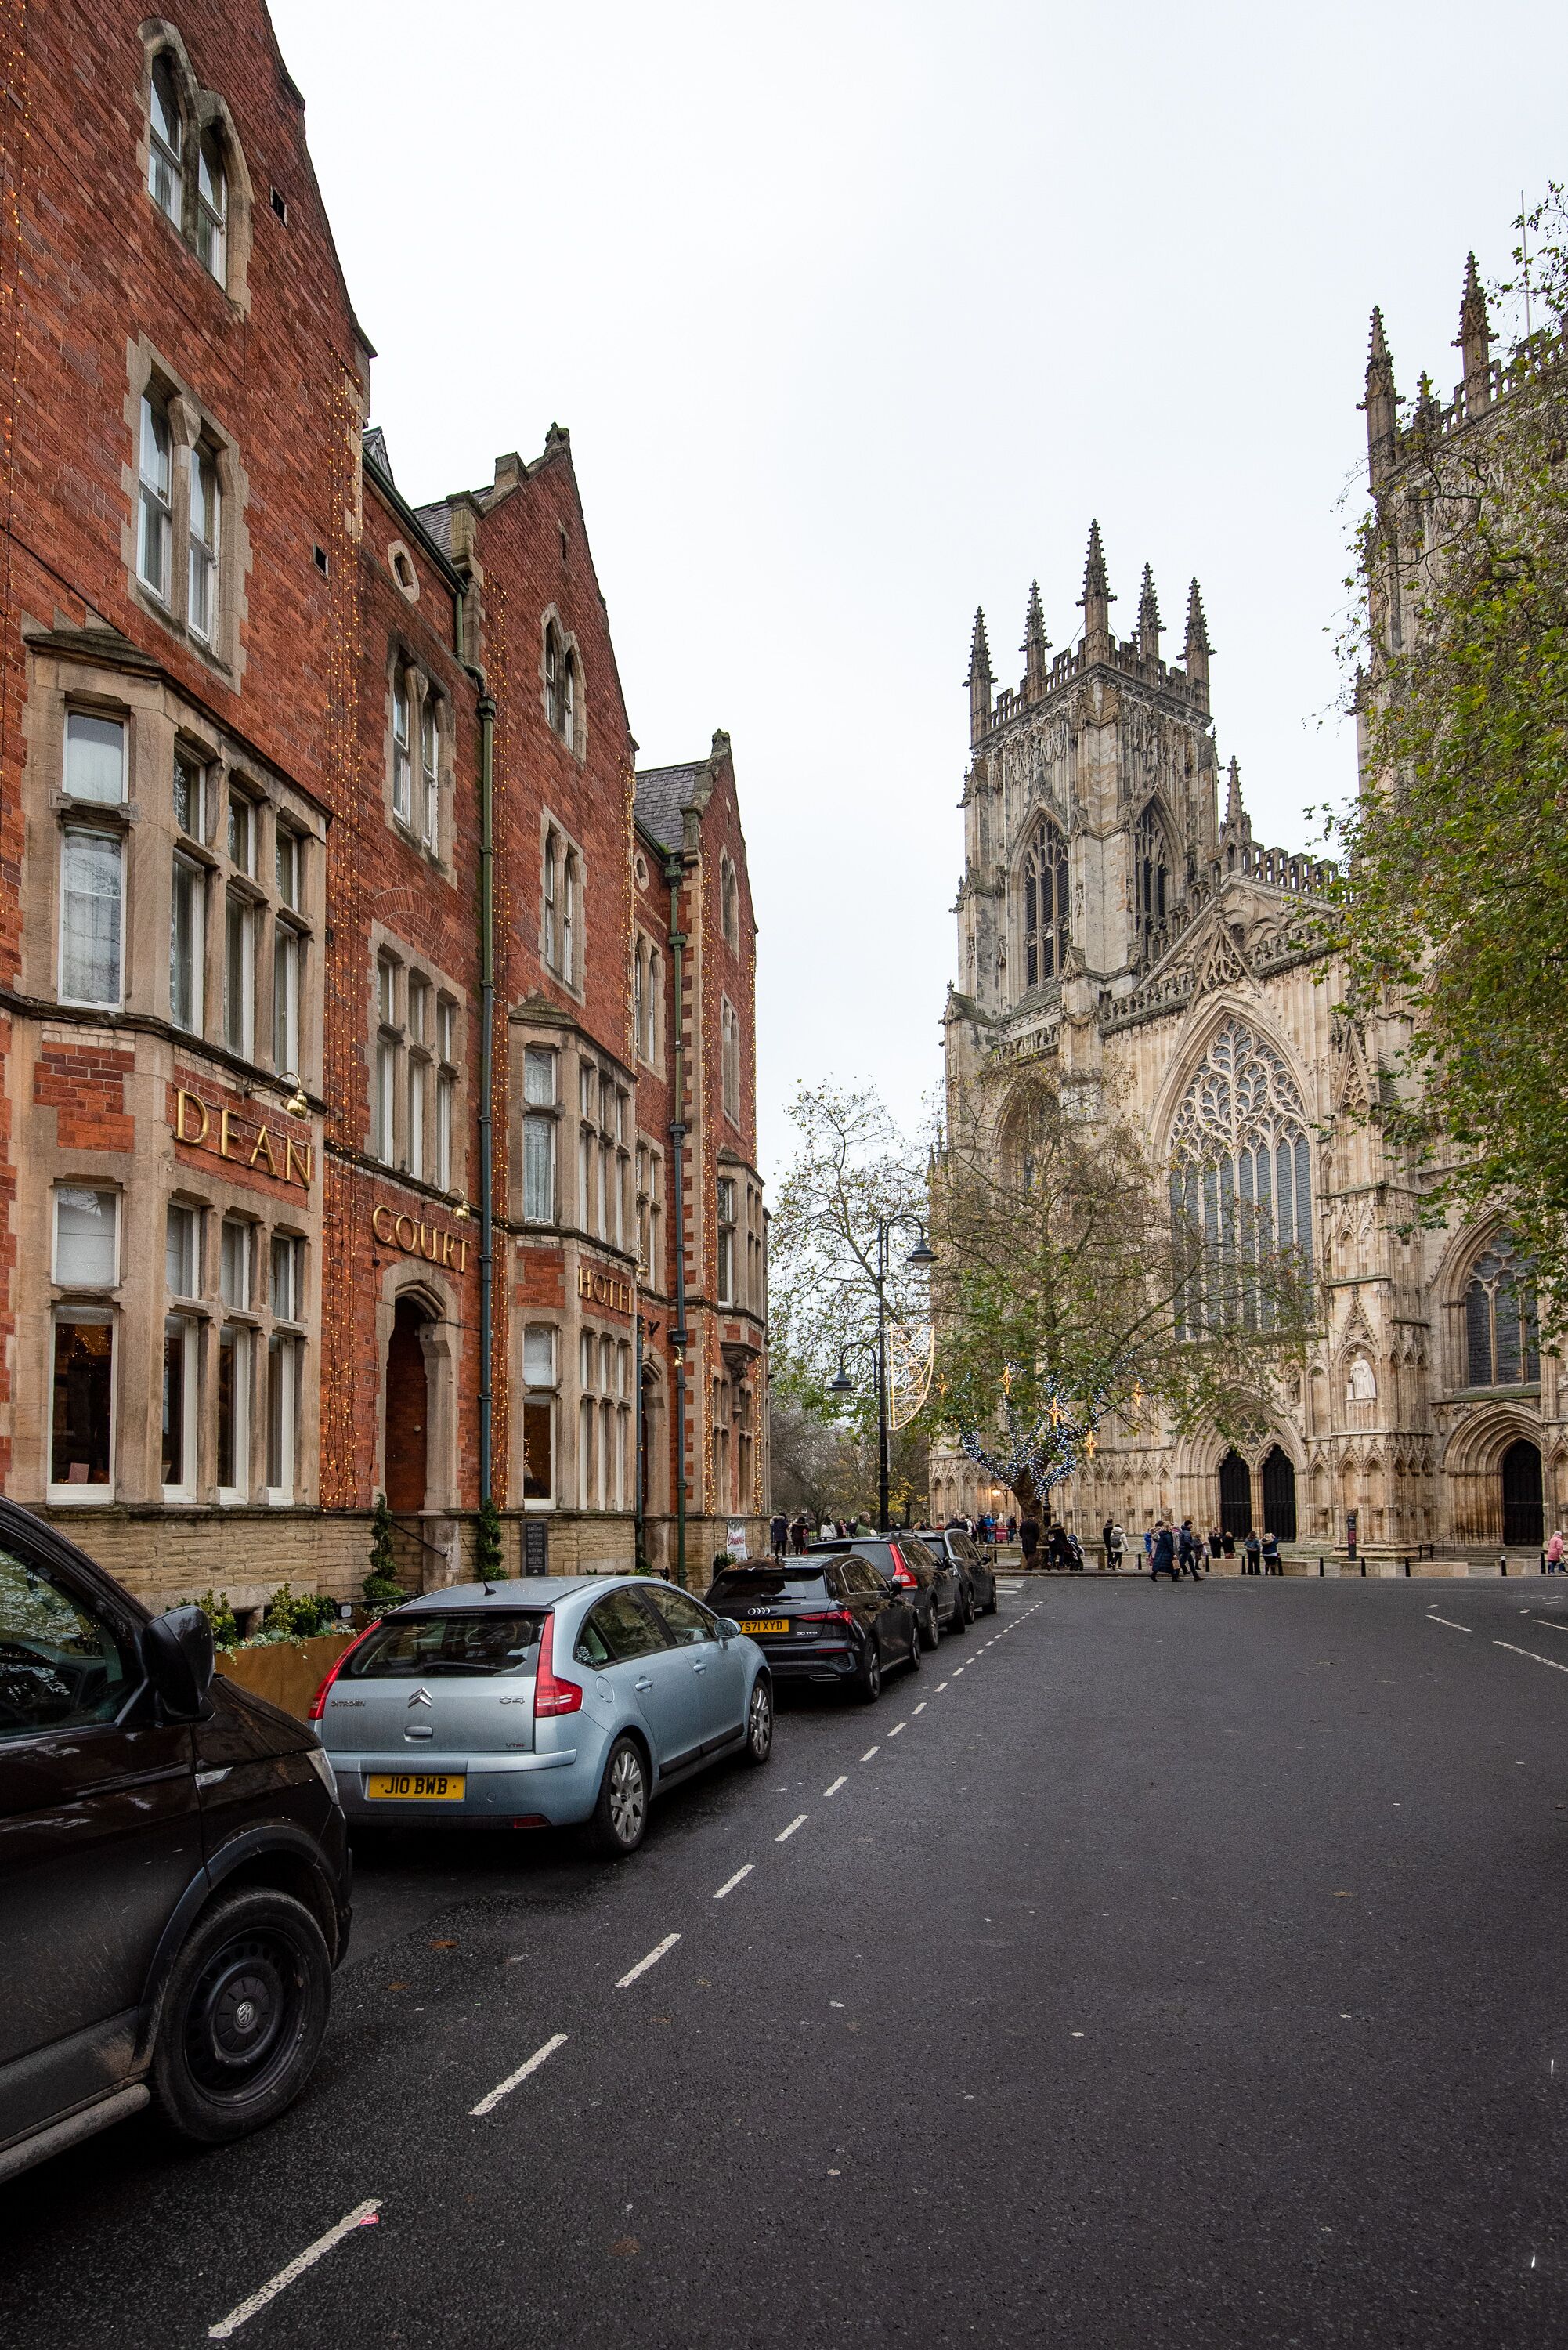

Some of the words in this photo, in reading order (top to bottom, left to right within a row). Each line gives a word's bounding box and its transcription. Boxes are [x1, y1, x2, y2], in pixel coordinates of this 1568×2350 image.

[175, 1087, 311, 1190] DEAN
[372, 1205, 471, 1272] COURT
[578, 1265, 635, 1316] HOTEL
[739, 1622, 761, 1632] YS71
[763, 1621, 783, 1631] XYD
[498, 1696, 526, 1705] C4
[384, 1777, 410, 1795] J10
[414, 1777, 448, 1795] BWB
